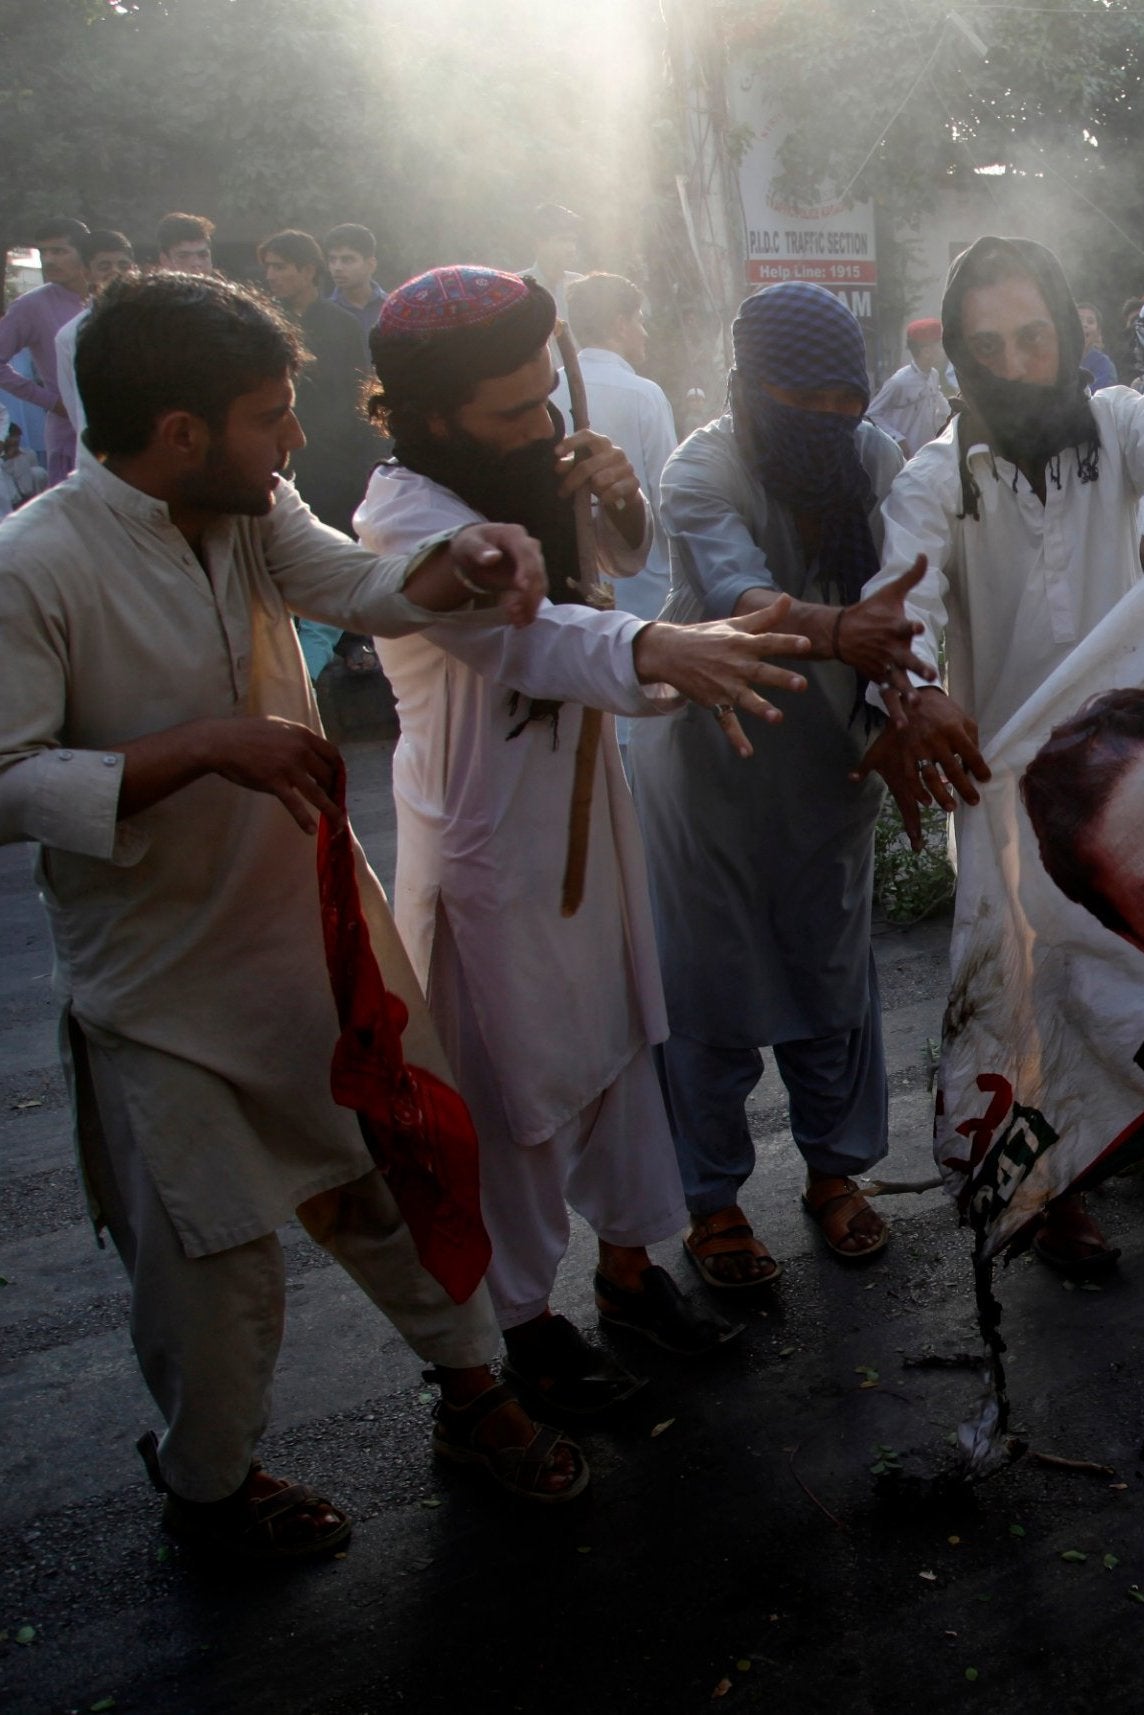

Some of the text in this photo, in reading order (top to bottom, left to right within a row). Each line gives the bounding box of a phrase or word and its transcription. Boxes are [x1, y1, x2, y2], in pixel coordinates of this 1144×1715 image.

[784, 231, 824, 255] TRAFFIC
[827, 232, 868, 255] SECTION
[760, 264, 861, 280] Help Line: 1915
